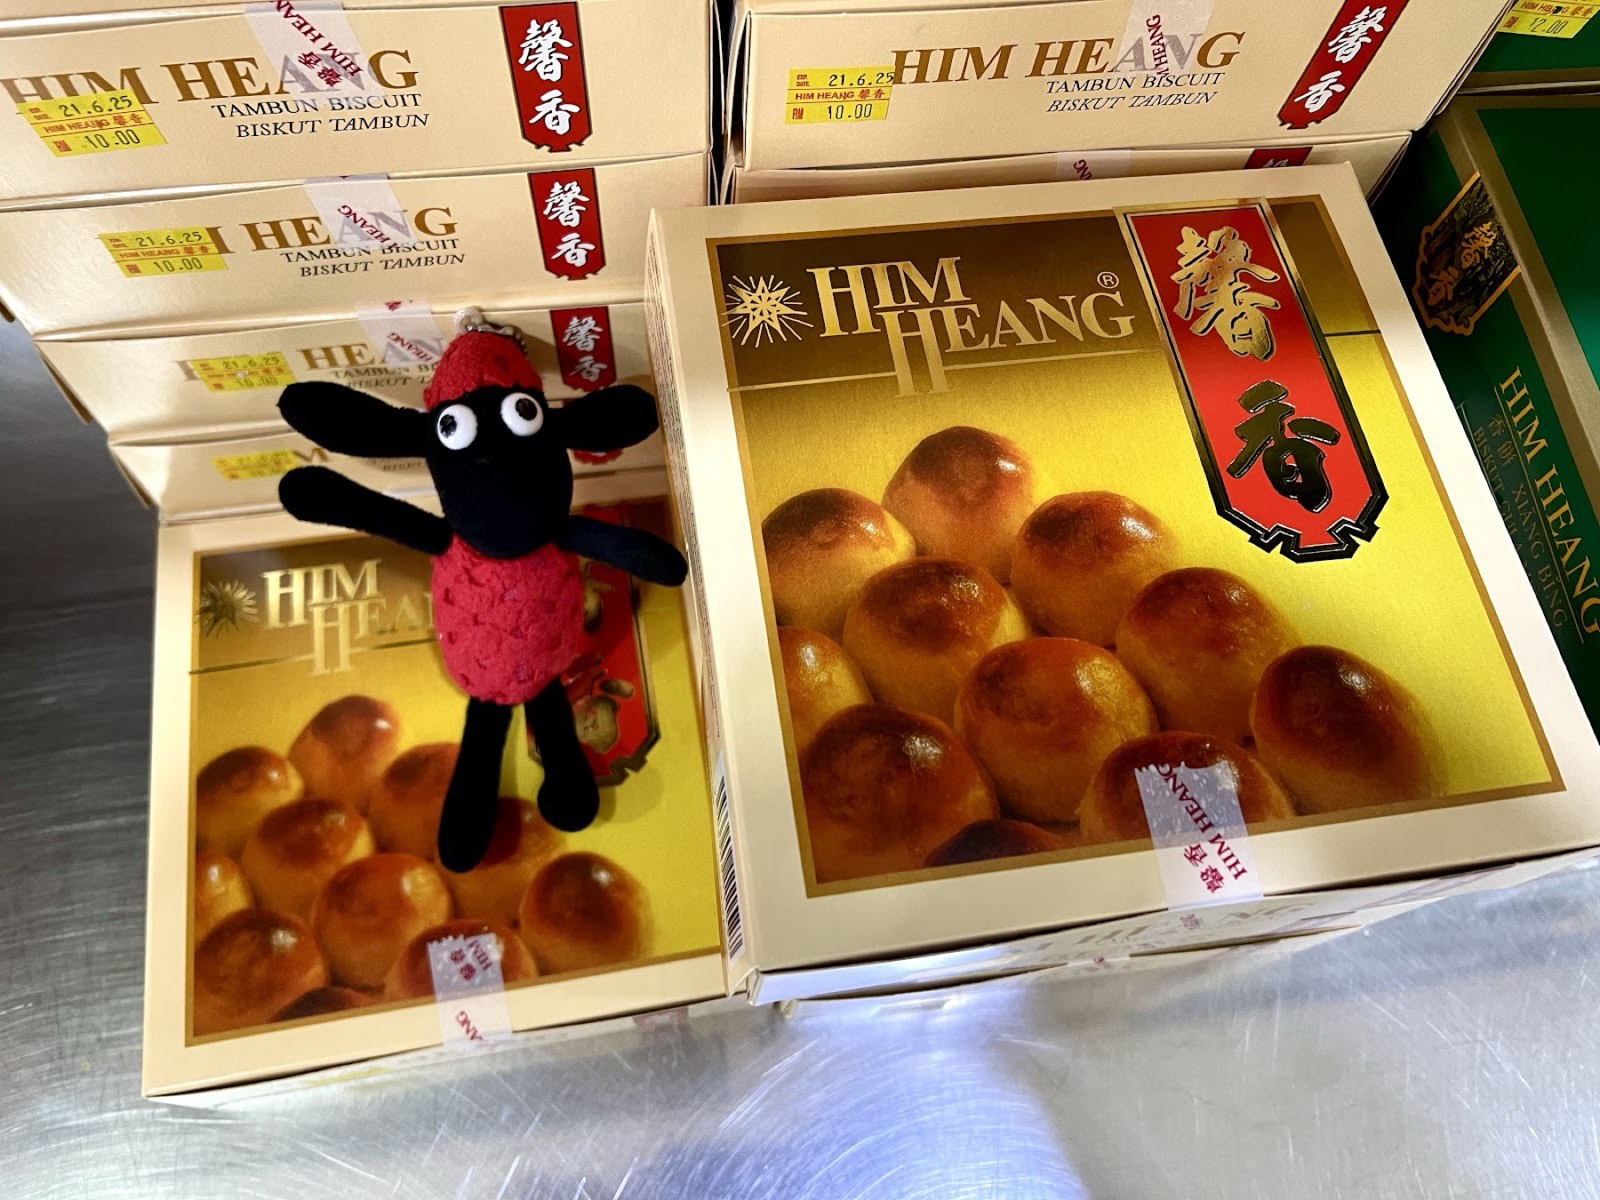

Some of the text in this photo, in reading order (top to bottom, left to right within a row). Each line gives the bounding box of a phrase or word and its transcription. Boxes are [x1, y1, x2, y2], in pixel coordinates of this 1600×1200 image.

[271, 0, 364, 77] HIM HEAN
[891, 31, 1246, 85] HIM HEANG
[1145, 14, 1168, 72] HEANG
[160, 50, 420, 103] HEANG
[298, 51, 343, 88] 馨香
[518, 18, 581, 136] 馨香
[828, 72, 894, 87] 21.6.25
[1294, 6, 1387, 113] 馨香
[817, 91, 855, 100] HEANG
[1046, 76, 1136, 94] TAMBUN
[1141, 72, 1225, 89] BISCUIT
[1046, 92, 1218, 113] BISKUT TAMBUN
[58, 95, 133, 118] 21.6.25
[211, 93, 422, 119] TAMBUN BISCUIT
[236, 114, 430, 138] BISKUT TAMBUN
[828, 103, 873, 120] 10.00
[85, 129, 141, 149] 10.00
[135, 231, 202, 248] 21.6.25
[239, 207, 458, 251] HEANG
[337, 204, 393, 244] HEANG
[543, 181, 597, 268] 馨香
[153, 257, 203, 273] 10.00
[280, 246, 371, 263] TAMBUN
[300, 253, 465, 278] BISKUT TAMBUN
[806, 255, 1136, 399] HIM HEANG
[298, 336, 444, 370] HEAN
[562, 316, 608, 382] 馨香
[1171, 225, 1341, 513] 馨香
[1499, 365, 1600, 634] HIM HEANG
[260, 558, 382, 630] HIM
[1184, 843, 1225, 893] 馨香
[1208, 832, 1247, 880] HIM
